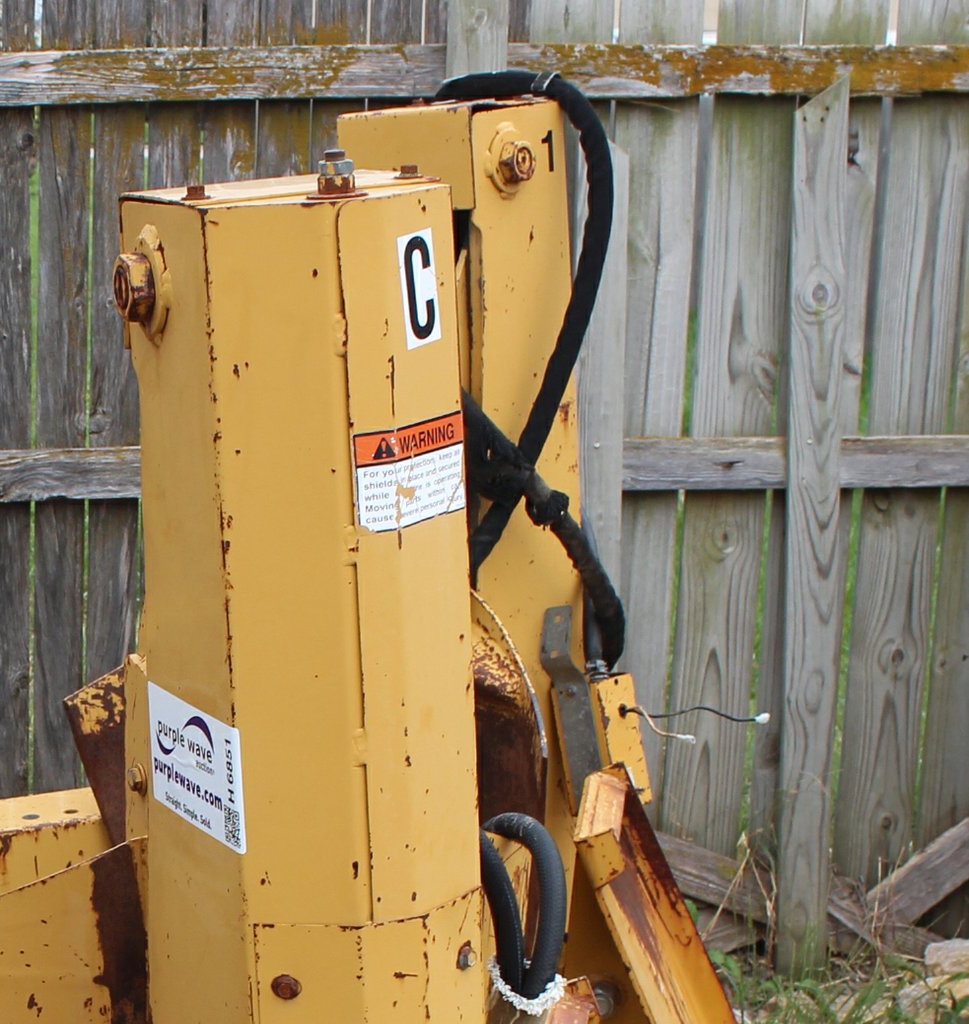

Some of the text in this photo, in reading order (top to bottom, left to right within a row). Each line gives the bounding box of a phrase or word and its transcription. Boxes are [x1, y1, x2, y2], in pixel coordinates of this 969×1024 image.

[541, 130, 554, 172] 1
[403, 235, 436, 340] C
[399, 423, 455, 454] WARNING
[363, 470, 379, 479] For
[364, 491, 391, 503] while
[157, 719, 214, 764] purple wave
[153, 756, 223, 811] purplewave.com
